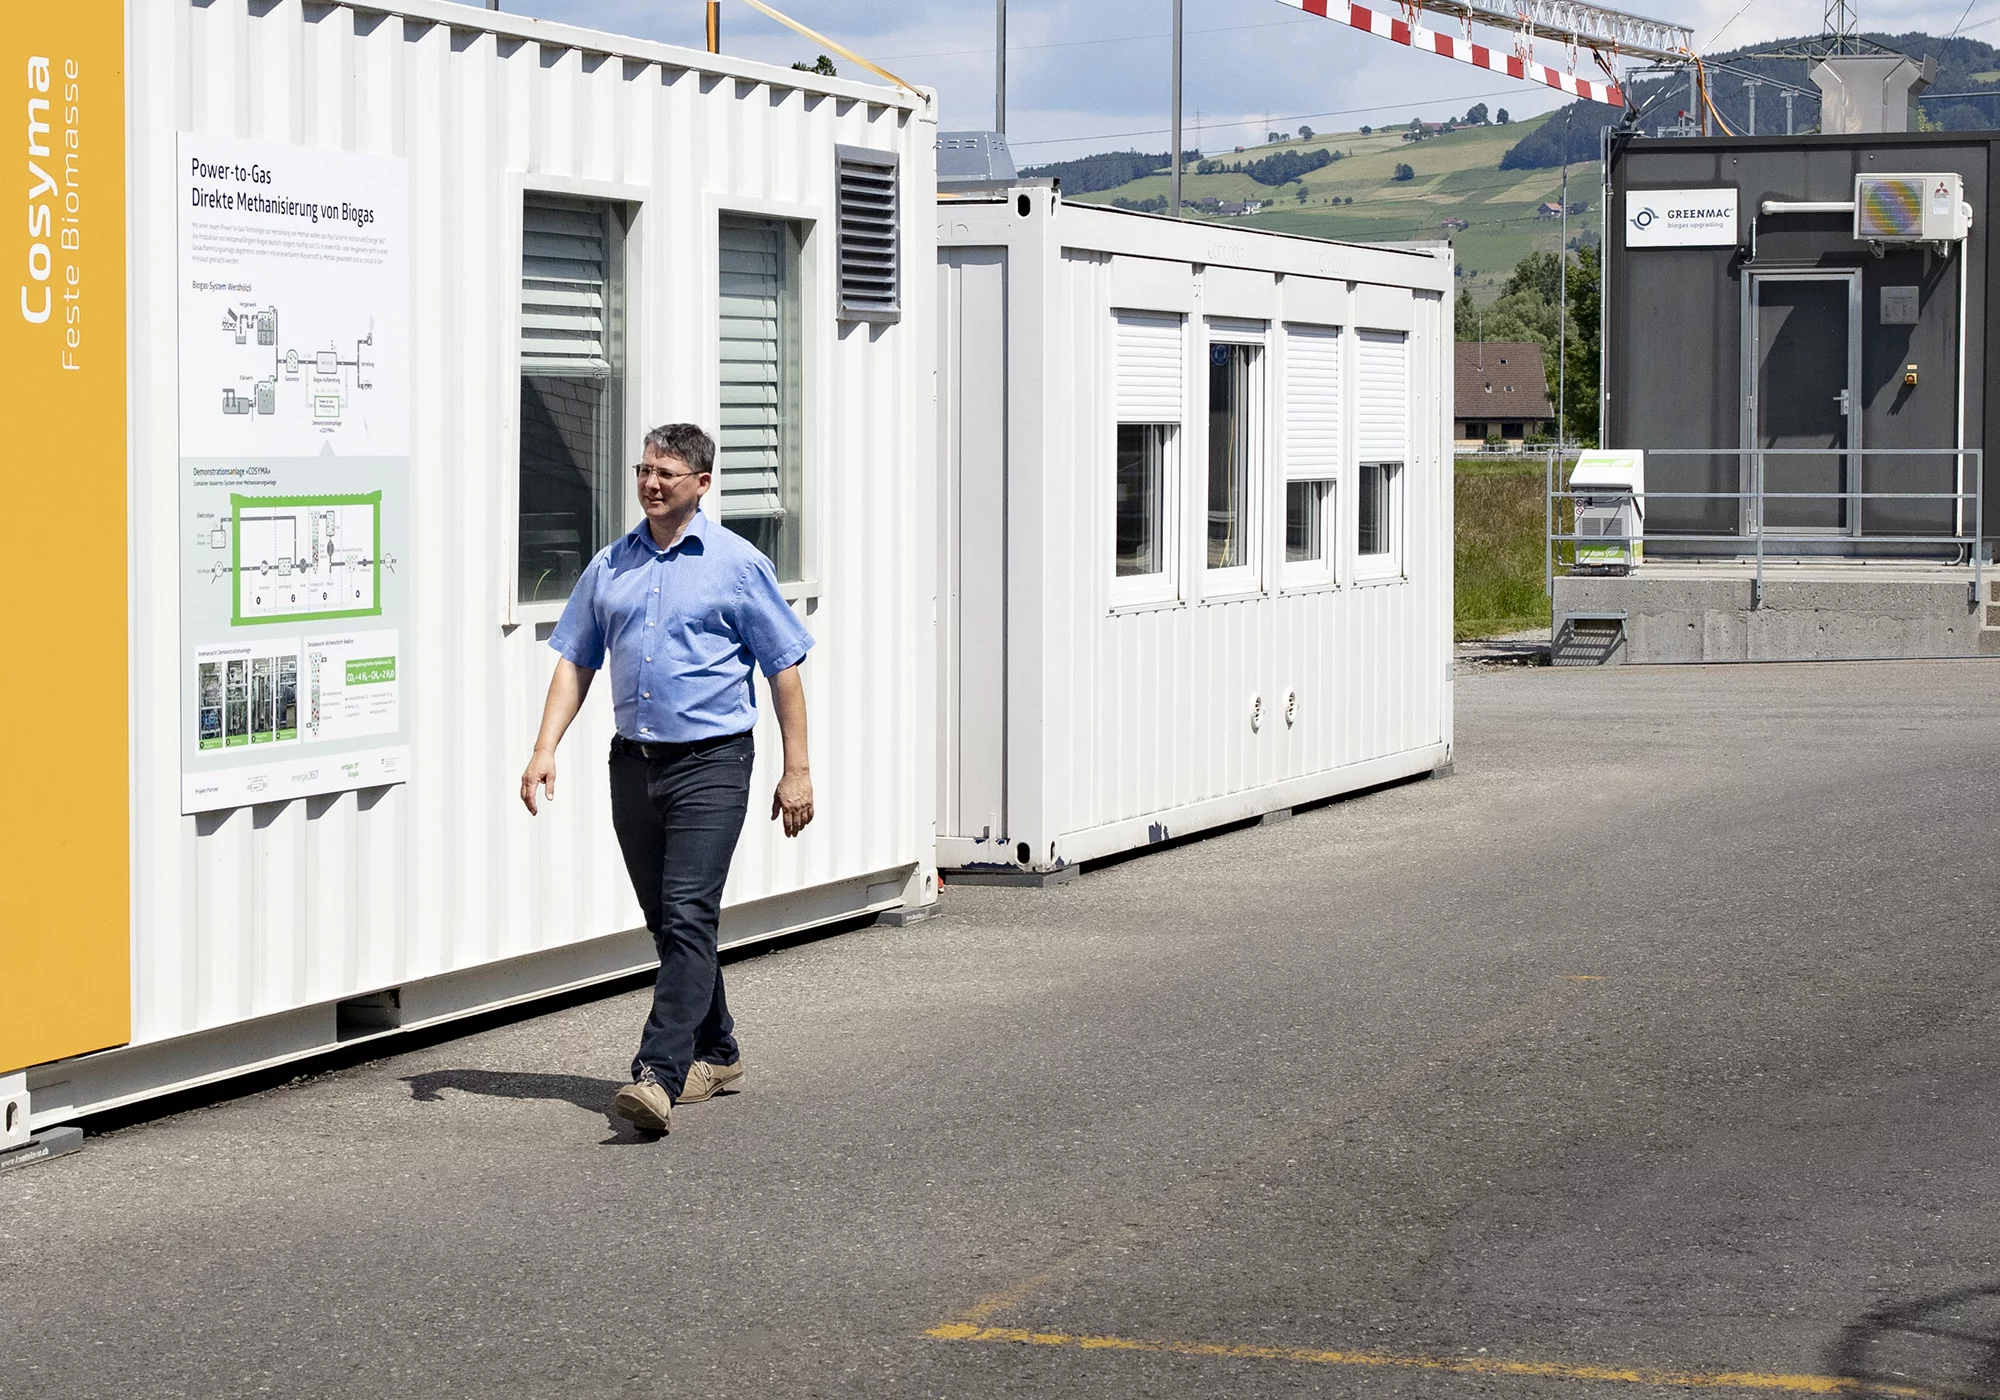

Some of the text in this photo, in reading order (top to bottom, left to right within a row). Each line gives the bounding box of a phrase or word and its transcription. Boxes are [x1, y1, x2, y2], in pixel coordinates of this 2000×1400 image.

[21, 56, 58, 324] Cosyma
[191, 158, 272, 184] Power-to-Gas
[61, 58, 80, 370] Feste Biomasse
[192, 187, 375, 227] Direkte Methanisierung von Biogas
[1667, 208, 1732, 219] GREENMAC
